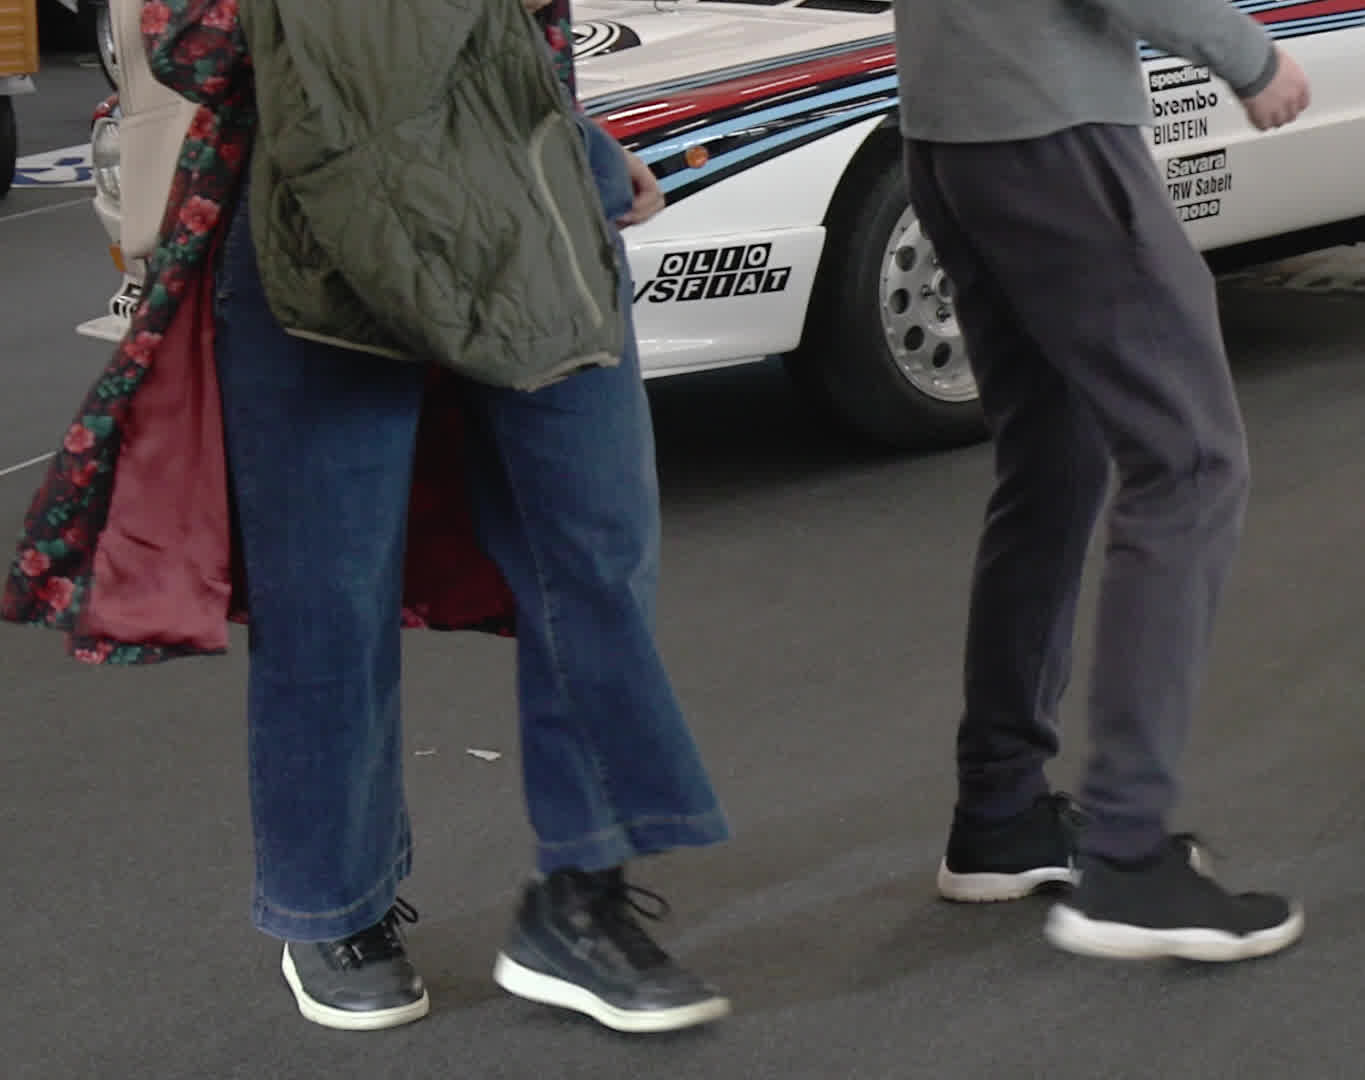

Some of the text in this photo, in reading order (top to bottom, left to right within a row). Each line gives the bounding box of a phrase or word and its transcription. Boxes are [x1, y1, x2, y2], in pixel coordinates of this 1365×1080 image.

[1151, 66, 1210, 91] speedline
[1152, 90, 1218, 118] brembo
[1153, 117, 1208, 146] BILSTEIN
[1168, 152, 1226, 179] Savara
[1195, 173, 1232, 197] Sabelt
[658, 244, 770, 276] OLIO
